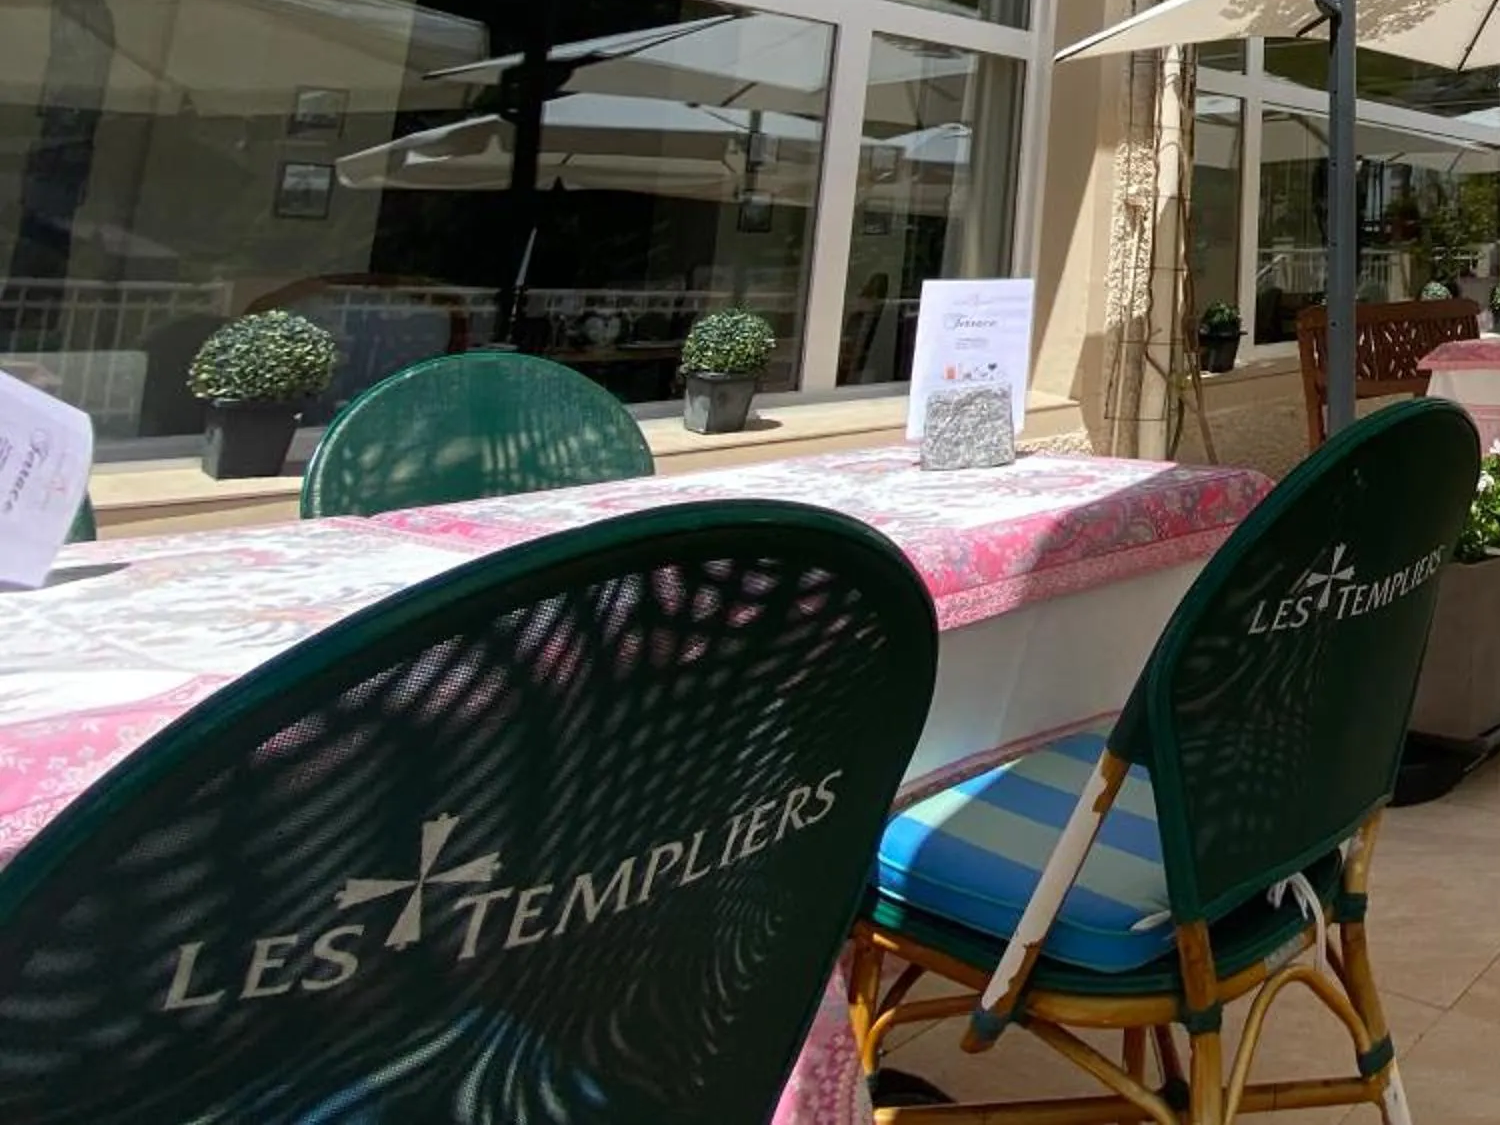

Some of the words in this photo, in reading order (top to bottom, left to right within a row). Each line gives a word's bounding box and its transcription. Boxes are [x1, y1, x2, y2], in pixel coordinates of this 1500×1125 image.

[1247, 595, 1313, 635] LES
[1336, 544, 1447, 621] TEMPLIERS
[162, 923, 365, 1012] LES
[452, 769, 844, 961] TEMPLIERS
